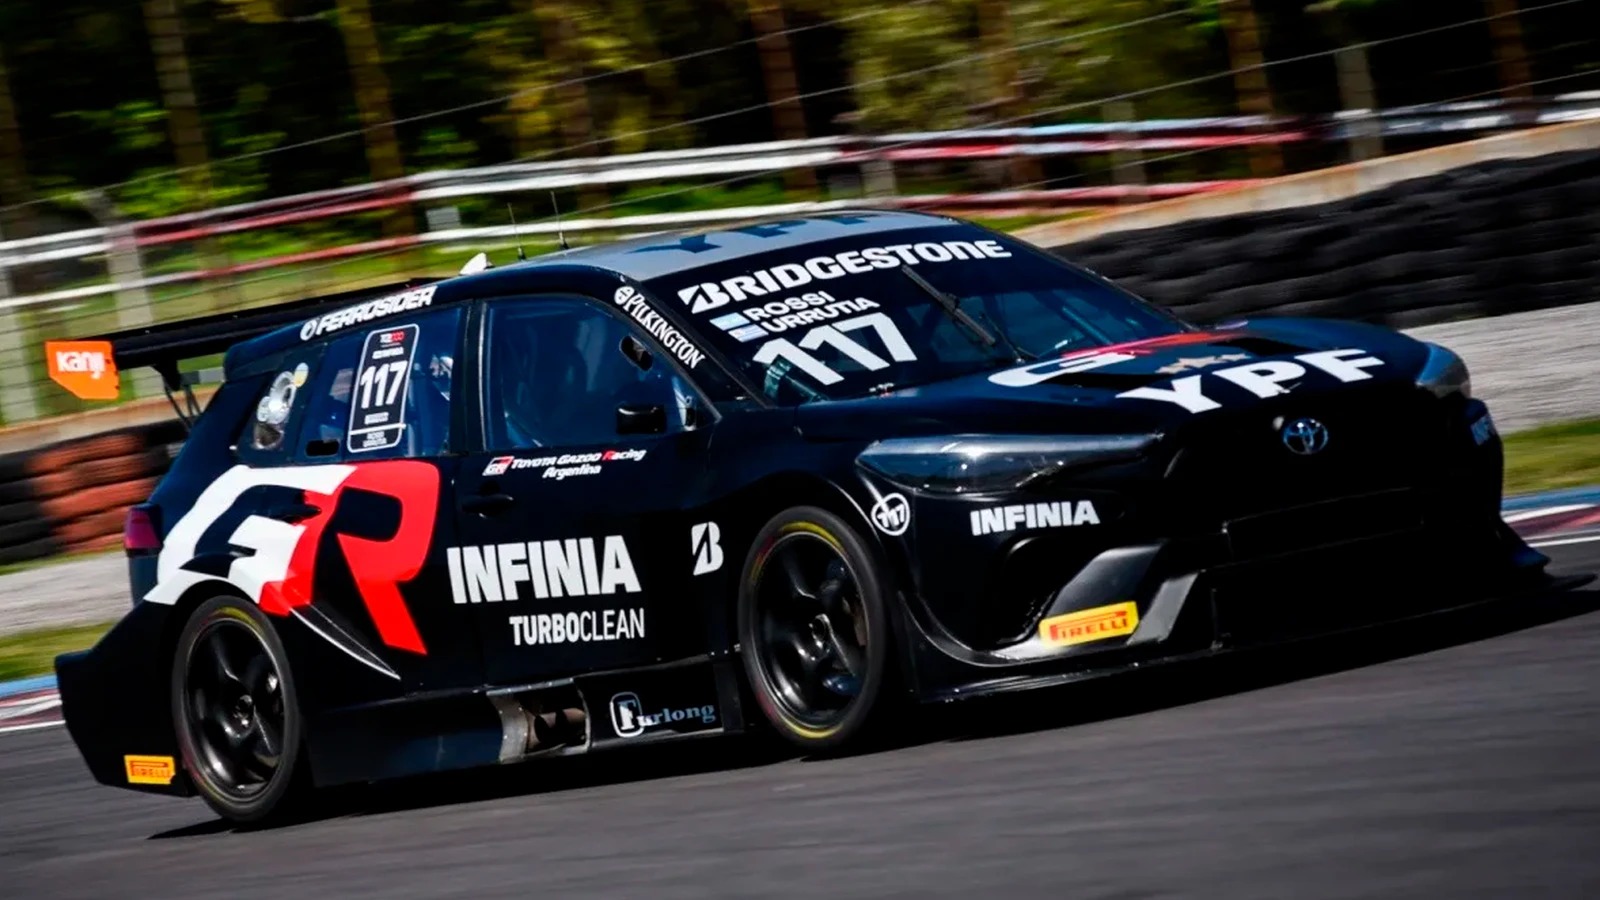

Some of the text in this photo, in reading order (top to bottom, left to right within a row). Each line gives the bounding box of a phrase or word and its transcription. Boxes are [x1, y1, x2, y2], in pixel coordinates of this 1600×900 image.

[677, 240, 1012, 314] BRIDGESTONE
[315, 285, 438, 336] FERROSIDER
[622, 292, 706, 369] PILKINGTON
[743, 290, 837, 322] ROSSI
[760, 297, 881, 333] URRUTIA
[752, 311, 918, 386] 117
[360, 360, 408, 409] 117
[1115, 348, 1384, 413] YPF
[542, 464, 602, 480] Argentina
[970, 500, 1100, 536] INFINIA
[142, 459, 439, 655] GR
[447, 535, 642, 604] INFINIA
[509, 608, 645, 646] TURBOCLEAN
[1049, 608, 1130, 642] PIRELLI
